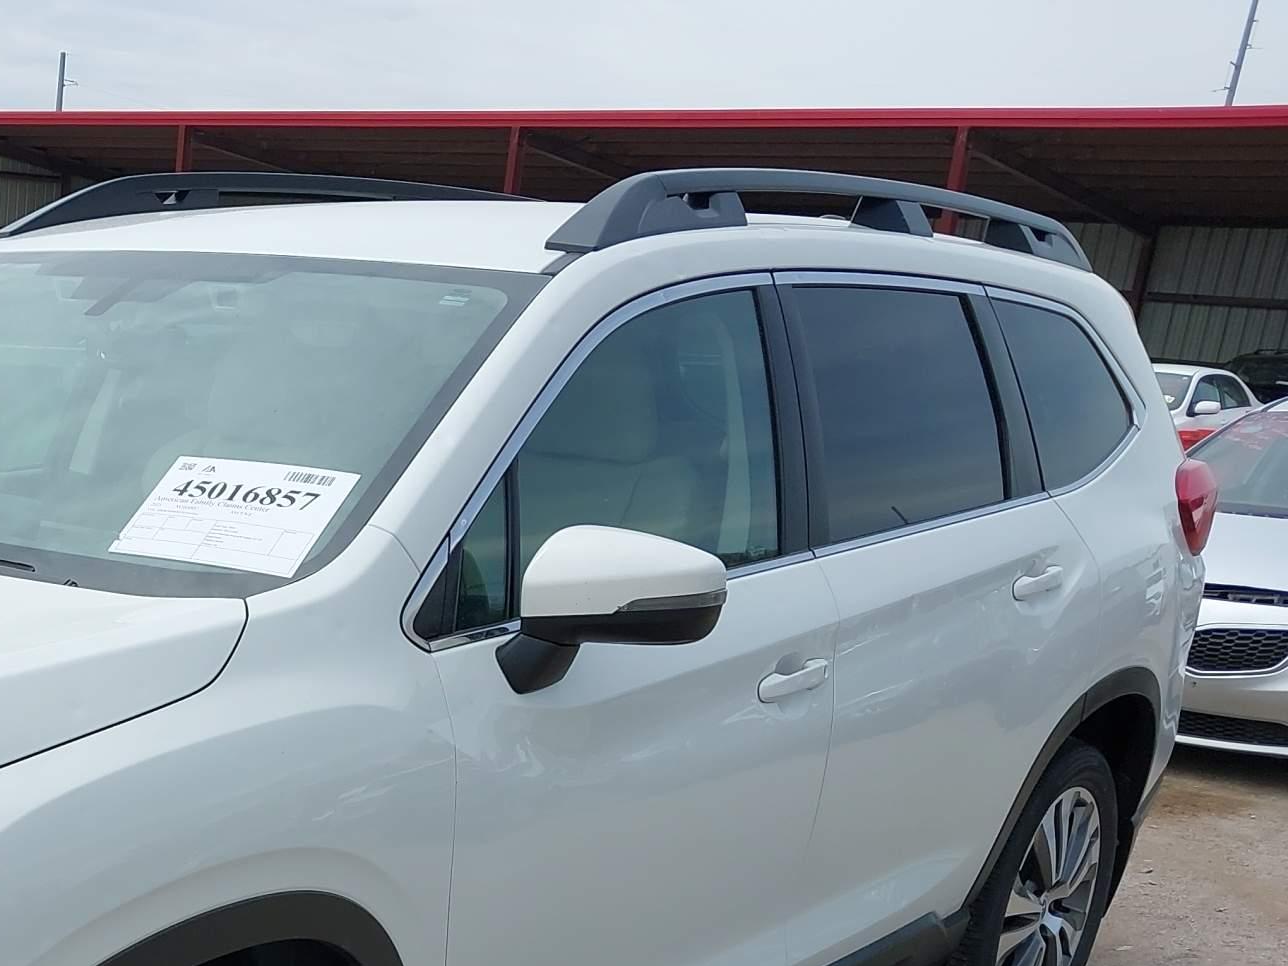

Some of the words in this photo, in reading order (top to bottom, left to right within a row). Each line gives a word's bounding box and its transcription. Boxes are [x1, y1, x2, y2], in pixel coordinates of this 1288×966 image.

[172, 479, 321, 511] 45016857
[190, 499, 215, 508] Family
[244, 504, 271, 513] Center
